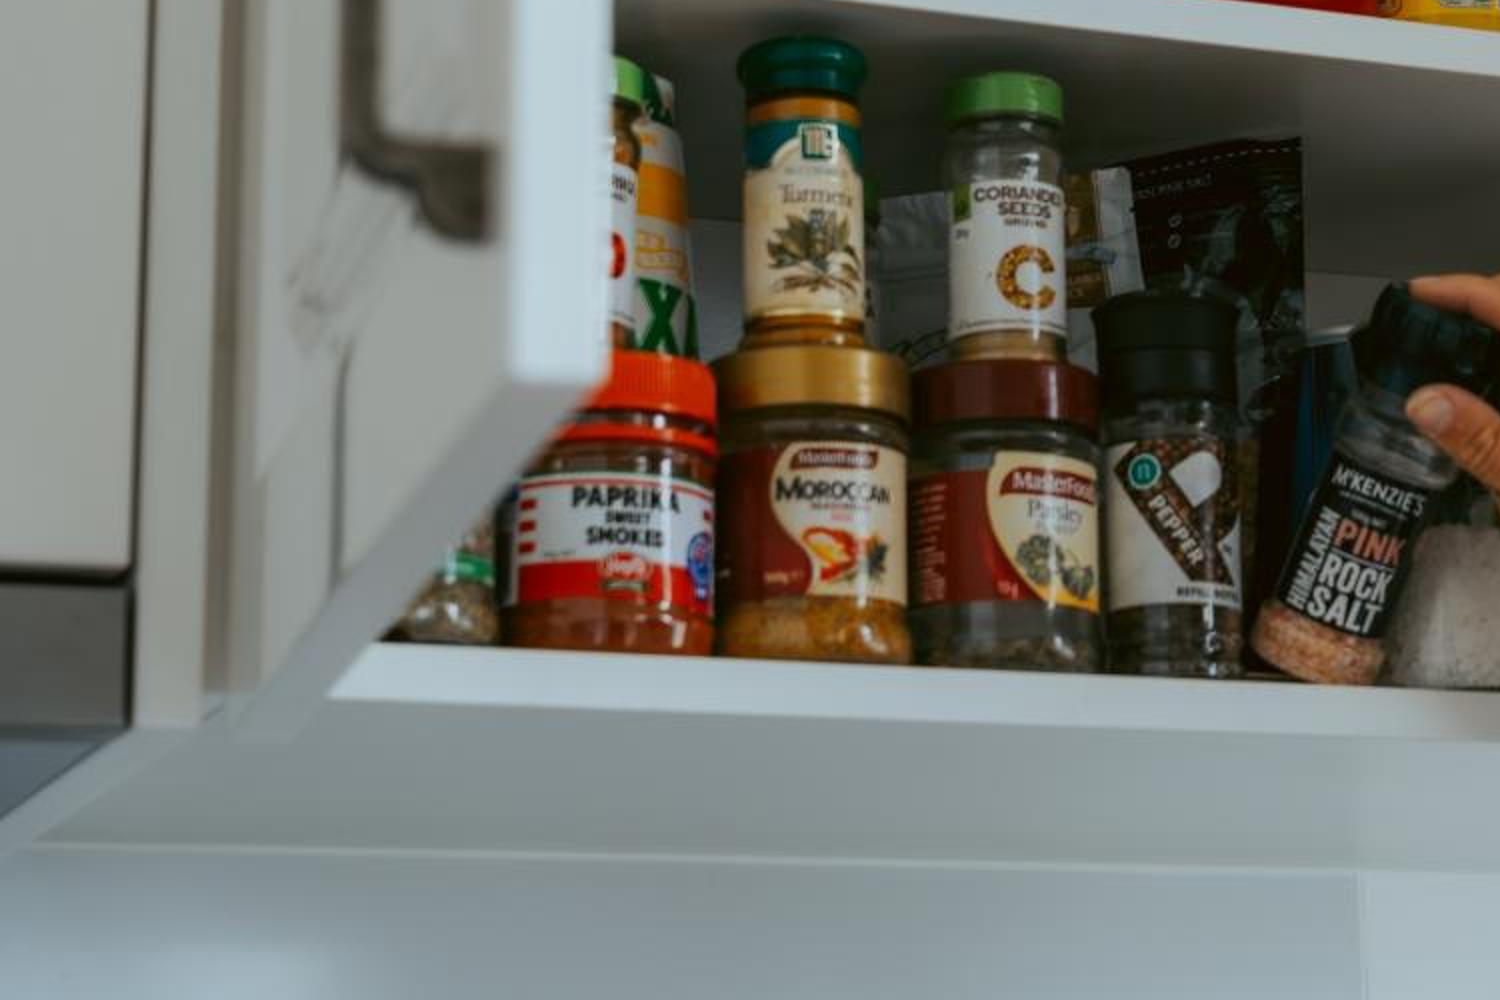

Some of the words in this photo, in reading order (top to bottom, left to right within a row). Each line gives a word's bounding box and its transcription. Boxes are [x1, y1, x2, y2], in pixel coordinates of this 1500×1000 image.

[998, 201, 1051, 219] SEEDS
[572, 485, 681, 514] PAPRIKA
[1148, 493, 1204, 566] PEPPER
[1333, 517, 1407, 568] PINK
[1286, 505, 1342, 610] HIMALAYAN
[1318, 552, 1394, 604] ROCK
[1306, 585, 1384, 634] SALT
